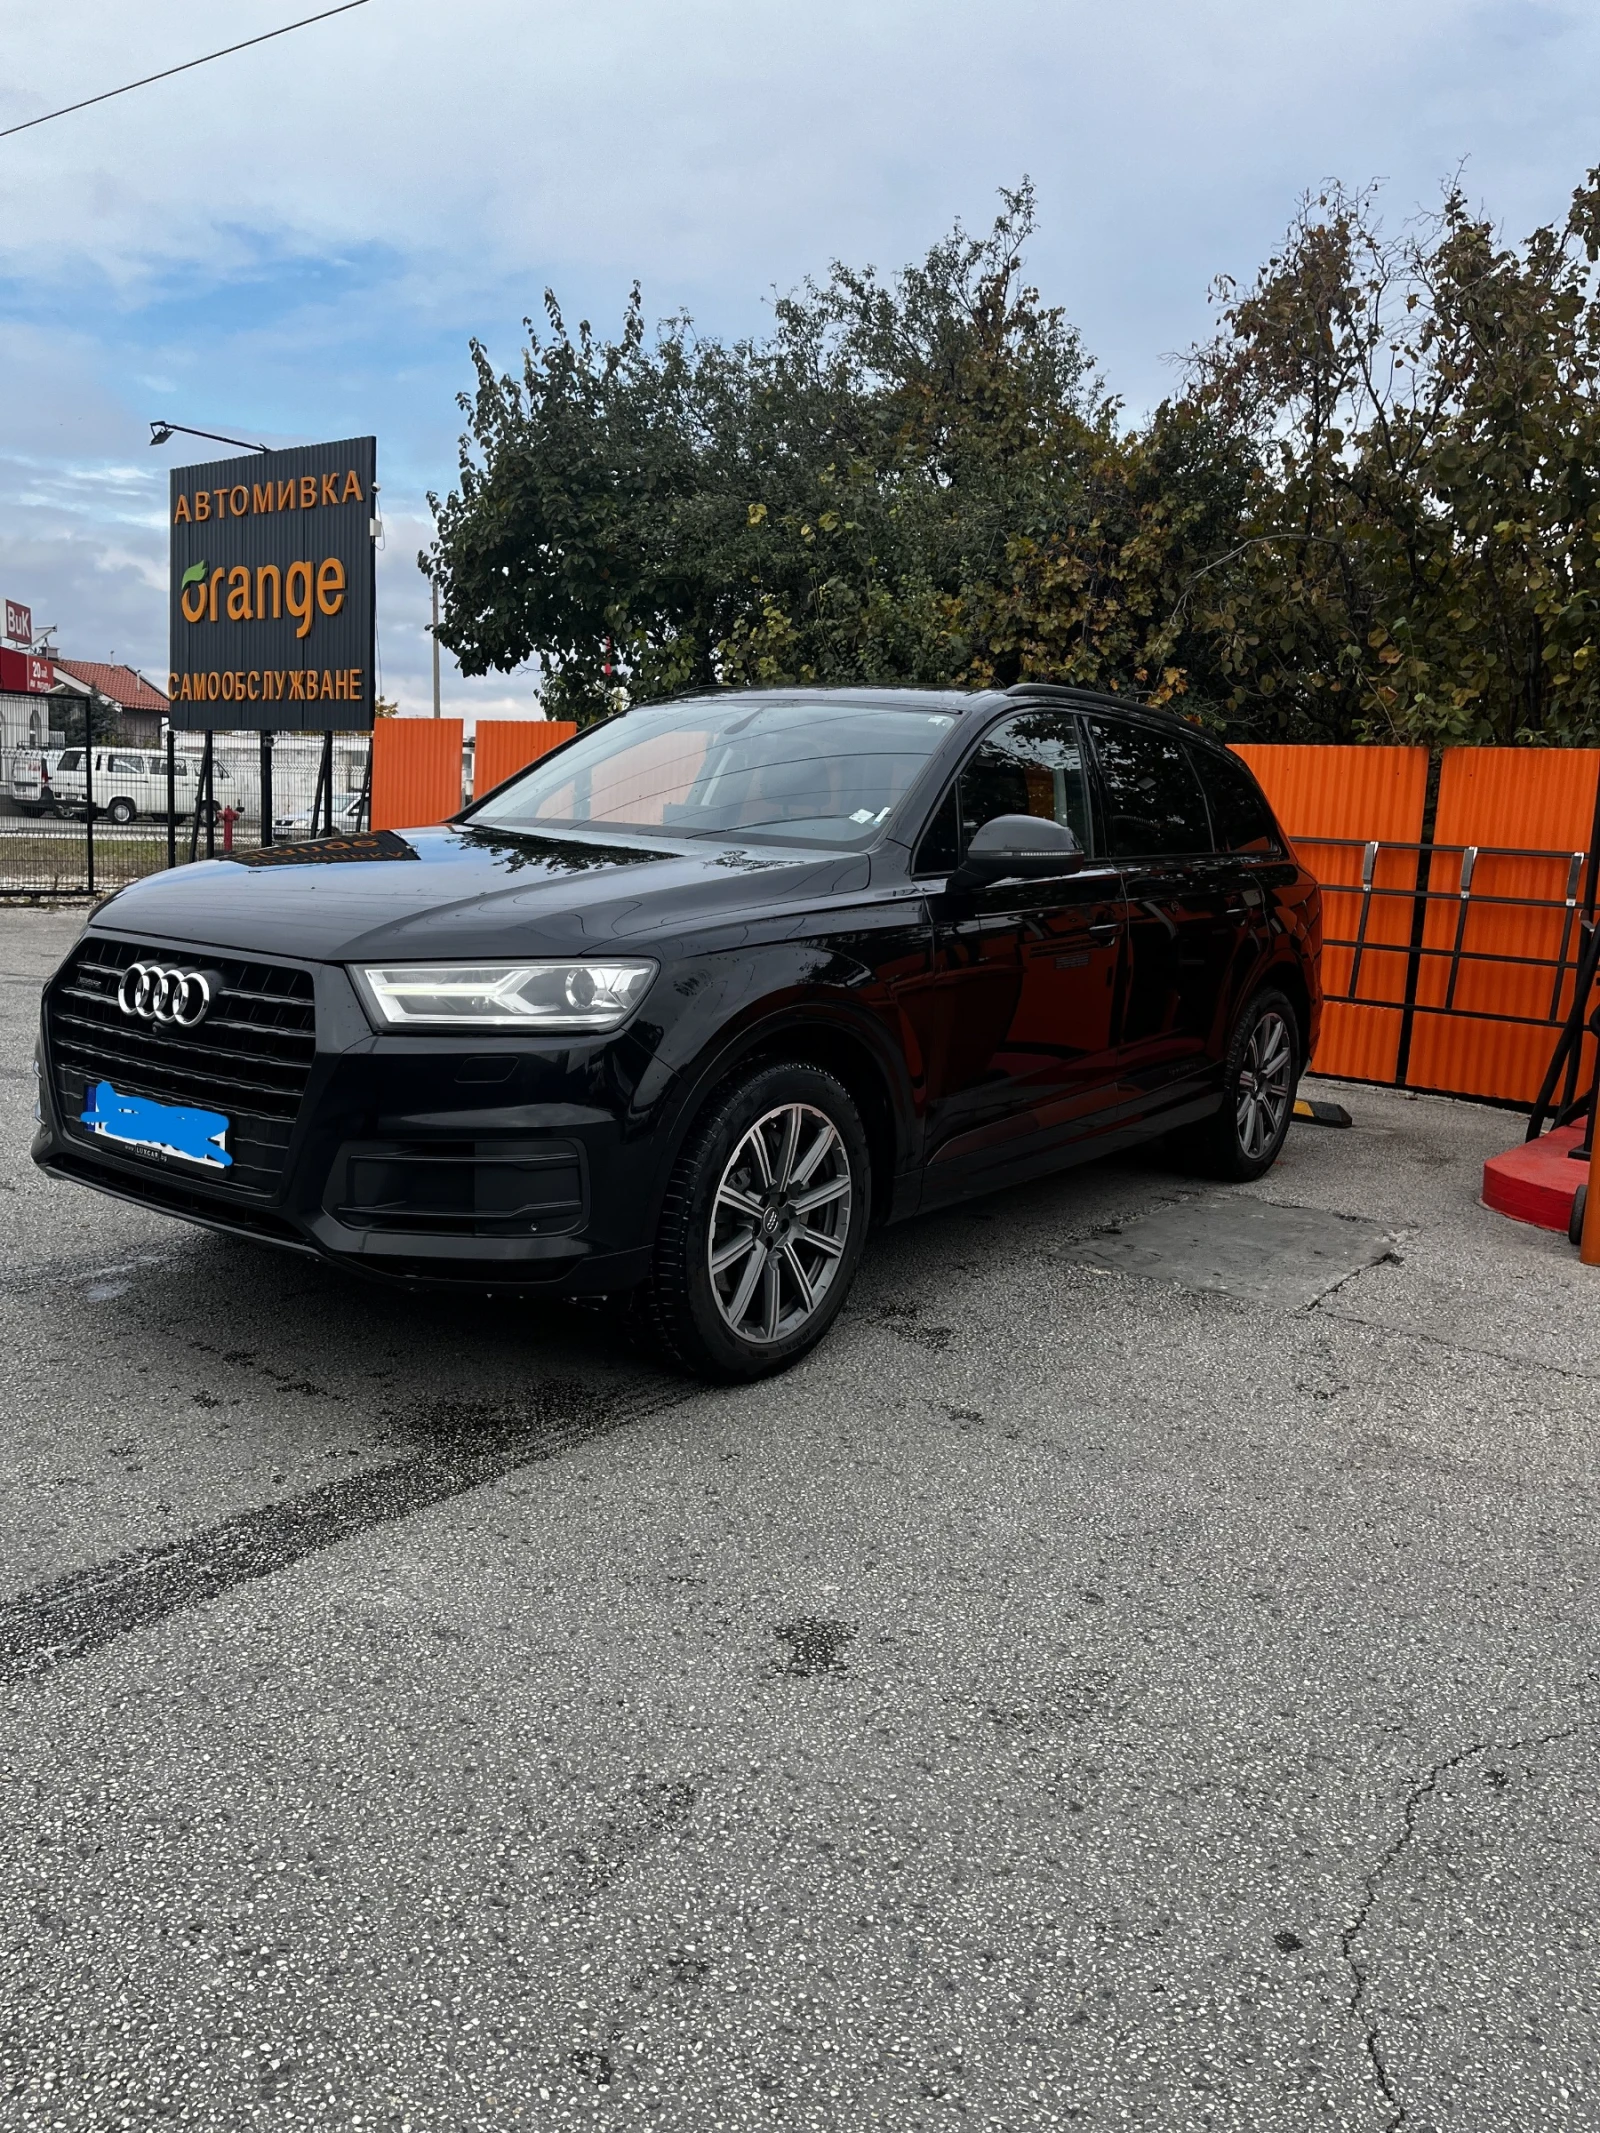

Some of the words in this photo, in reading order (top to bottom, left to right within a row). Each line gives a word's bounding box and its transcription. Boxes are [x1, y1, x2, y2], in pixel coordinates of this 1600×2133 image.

[174, 470, 364, 524] АВТОМИВКА
[181, 557, 346, 639] orange
[168, 668, 363, 701] САМООБСЛУЖВАНЕ
